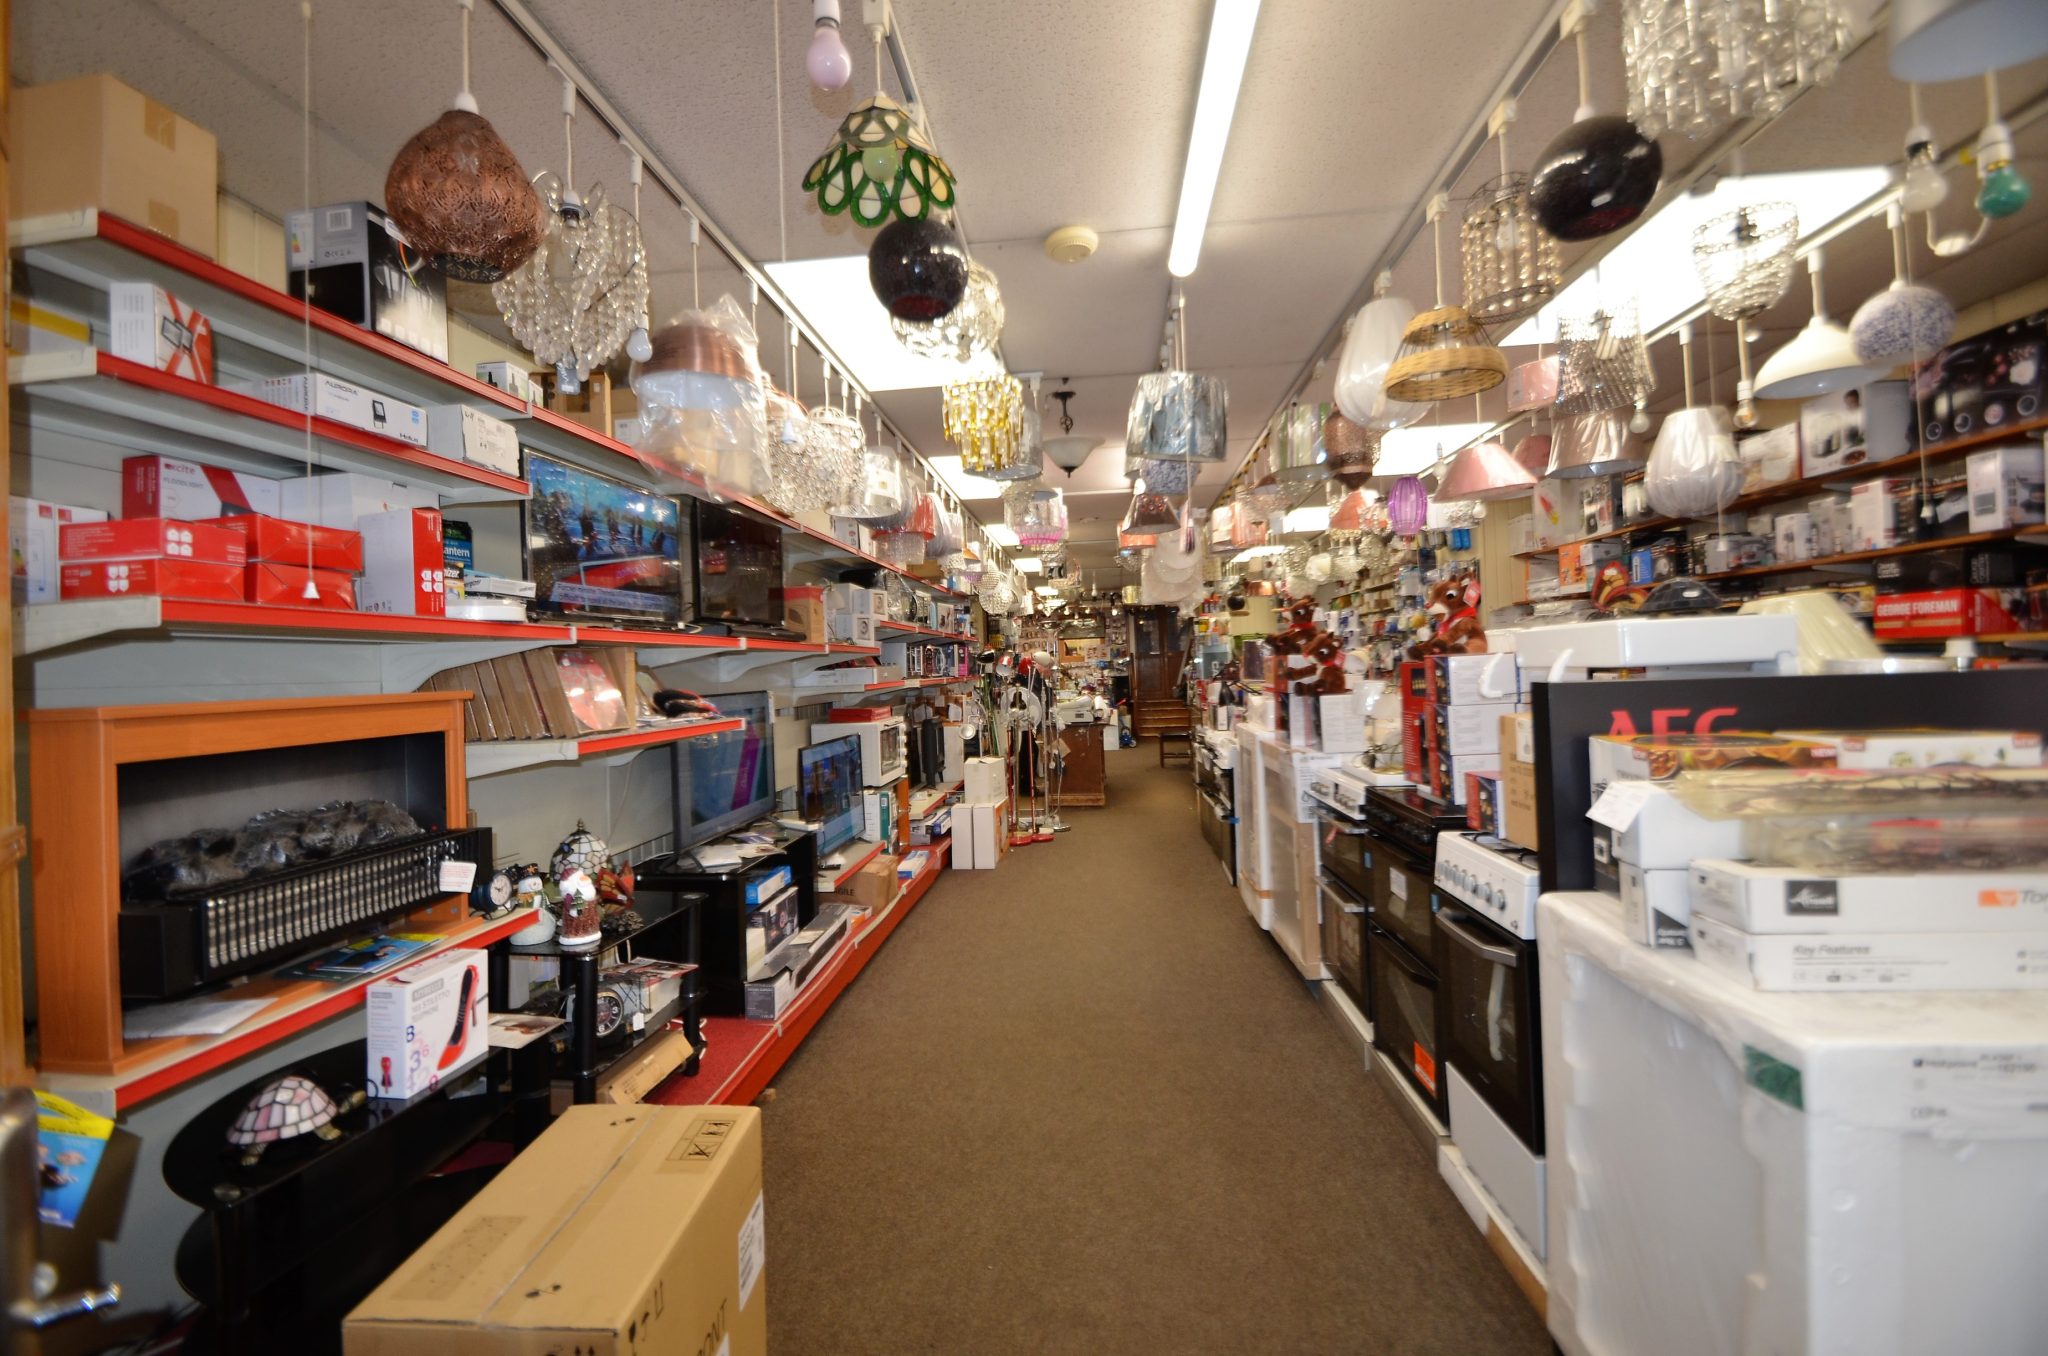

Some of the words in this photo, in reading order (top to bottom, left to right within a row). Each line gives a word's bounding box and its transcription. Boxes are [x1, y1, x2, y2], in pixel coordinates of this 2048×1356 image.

[444, 546, 470, 557] antern
[1877, 603, 1911, 617] GEORGE
[1912, 599, 1959, 614] FOREMAN
